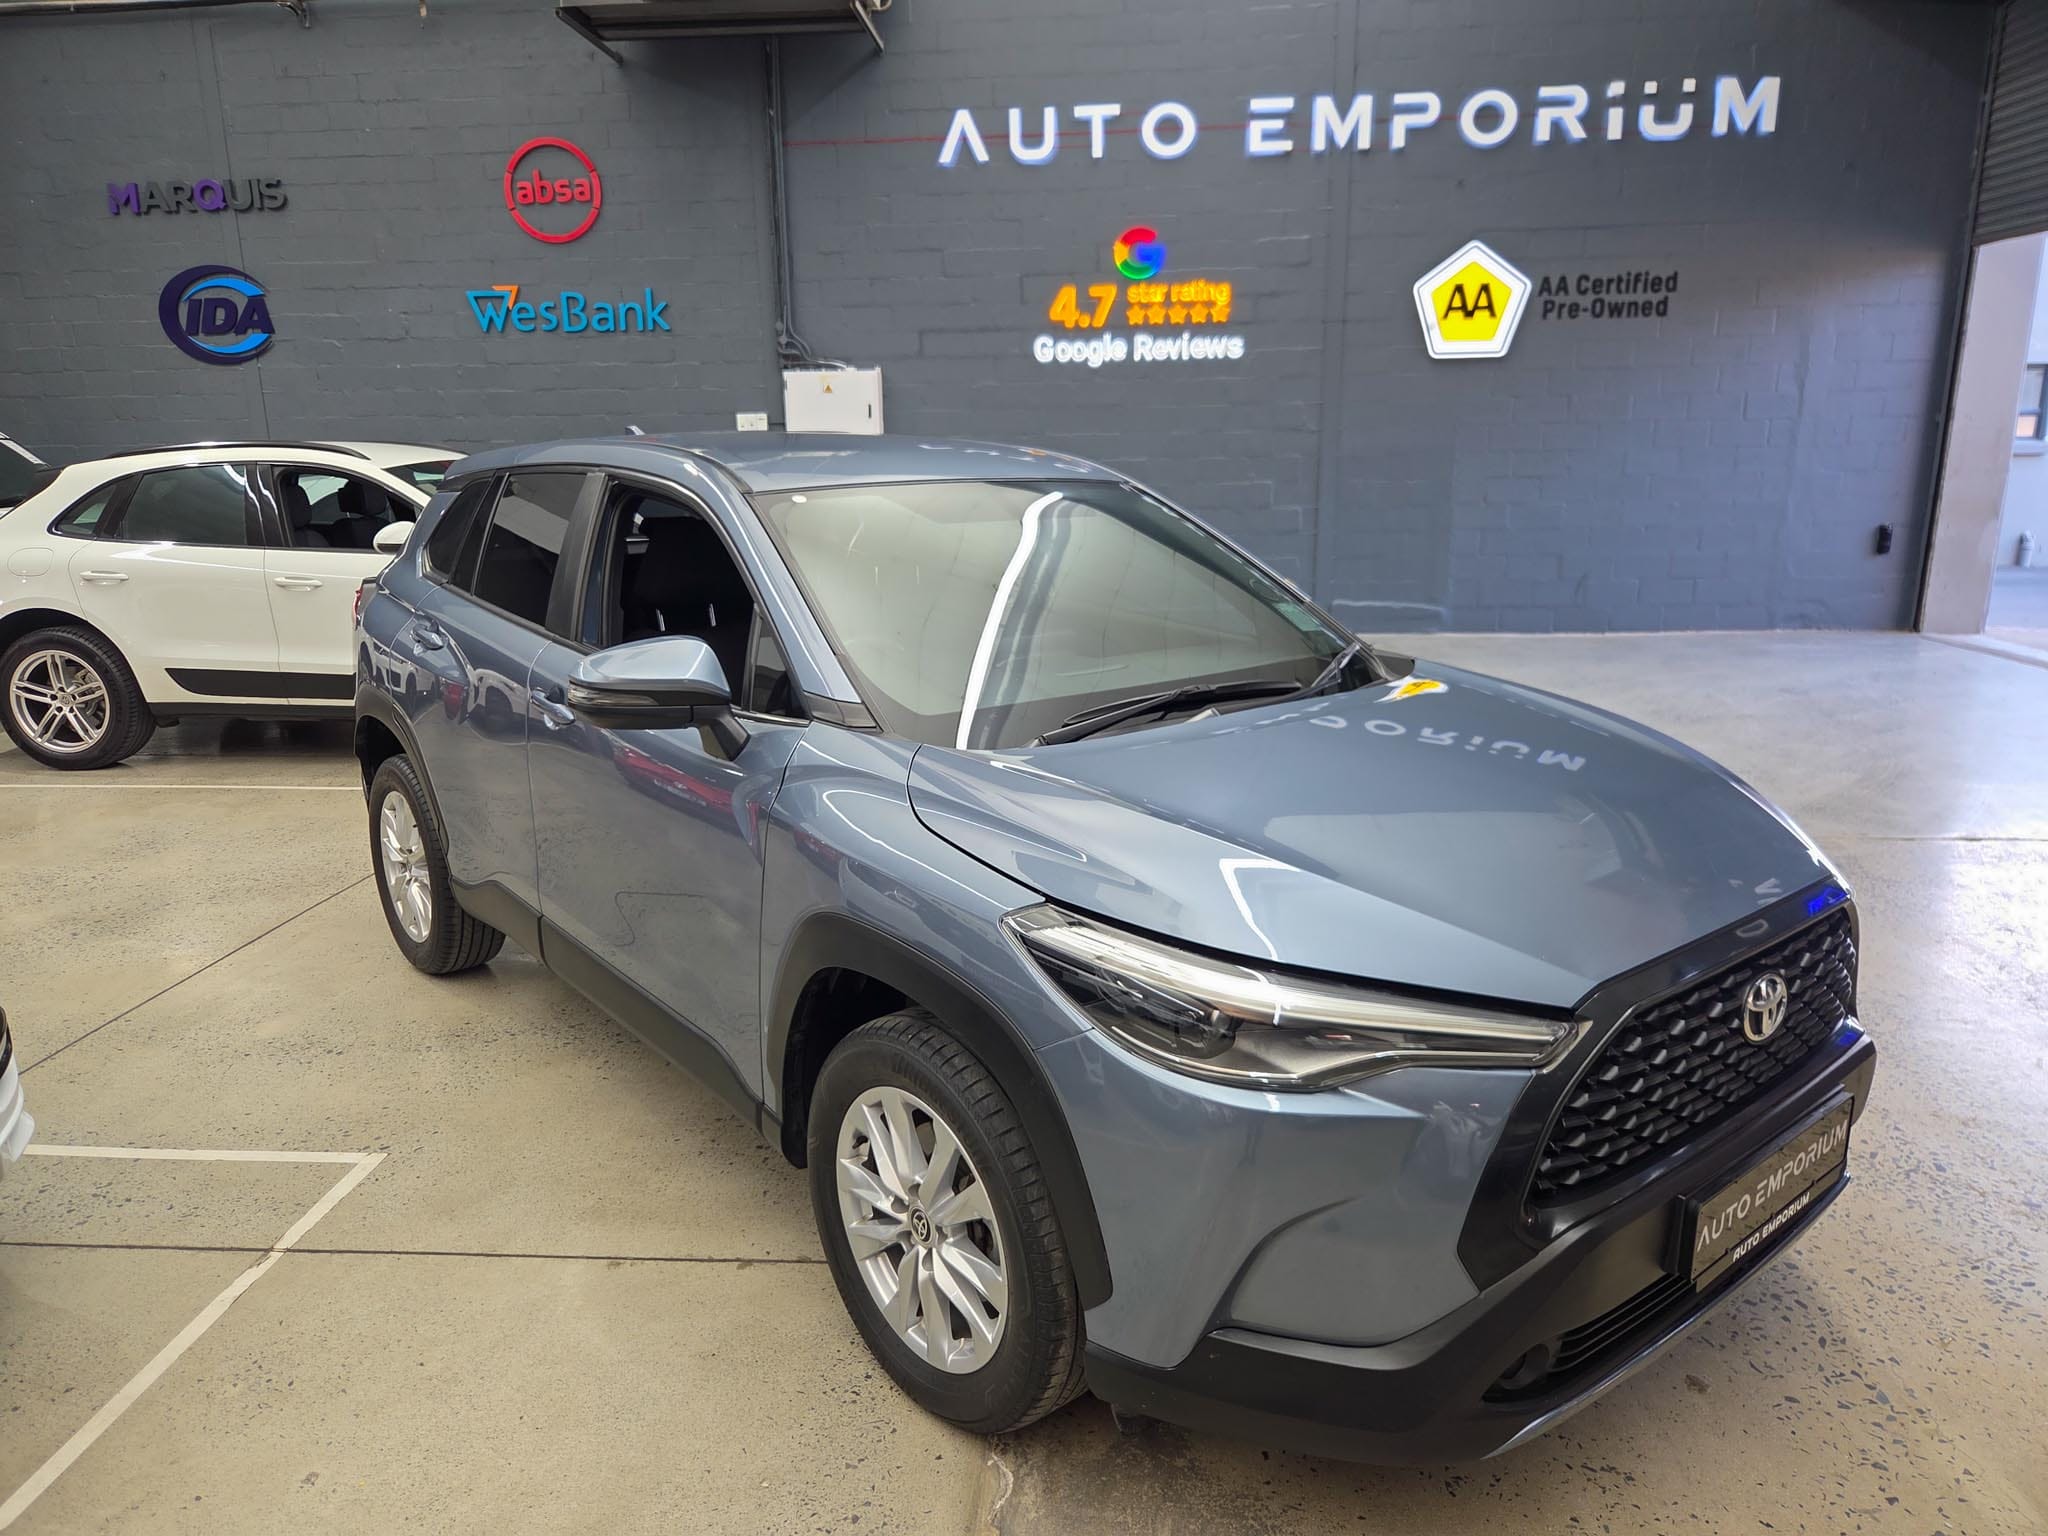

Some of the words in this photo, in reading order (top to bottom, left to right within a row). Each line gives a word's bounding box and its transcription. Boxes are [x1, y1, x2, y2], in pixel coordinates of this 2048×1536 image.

[938, 102, 1196, 167] AUTO
[106, 177, 287, 217] MARQUIS
[514, 169, 592, 205] absa
[1049, 283, 1118, 329] 4.7
[1126, 282, 1168, 303] star
[1170, 279, 1232, 305] rating
[1443, 283, 1497, 320] AA
[1538, 275, 1569, 297] AA
[1576, 271, 1678, 296] Certified
[184, 296, 275, 336] IDA
[466, 285, 671, 332] WesBank
[1542, 296, 1669, 320] Pre-Owned
[1033, 331, 1128, 368] Google
[1132, 329, 1245, 362] Reviews
[1697, 1194, 1750, 1252] AUTO
[1755, 1119, 1848, 1207] EMPORIUM
[1733, 1232, 1760, 1262] AUTO
[1762, 1192, 1810, 1239] EMPORIUM
